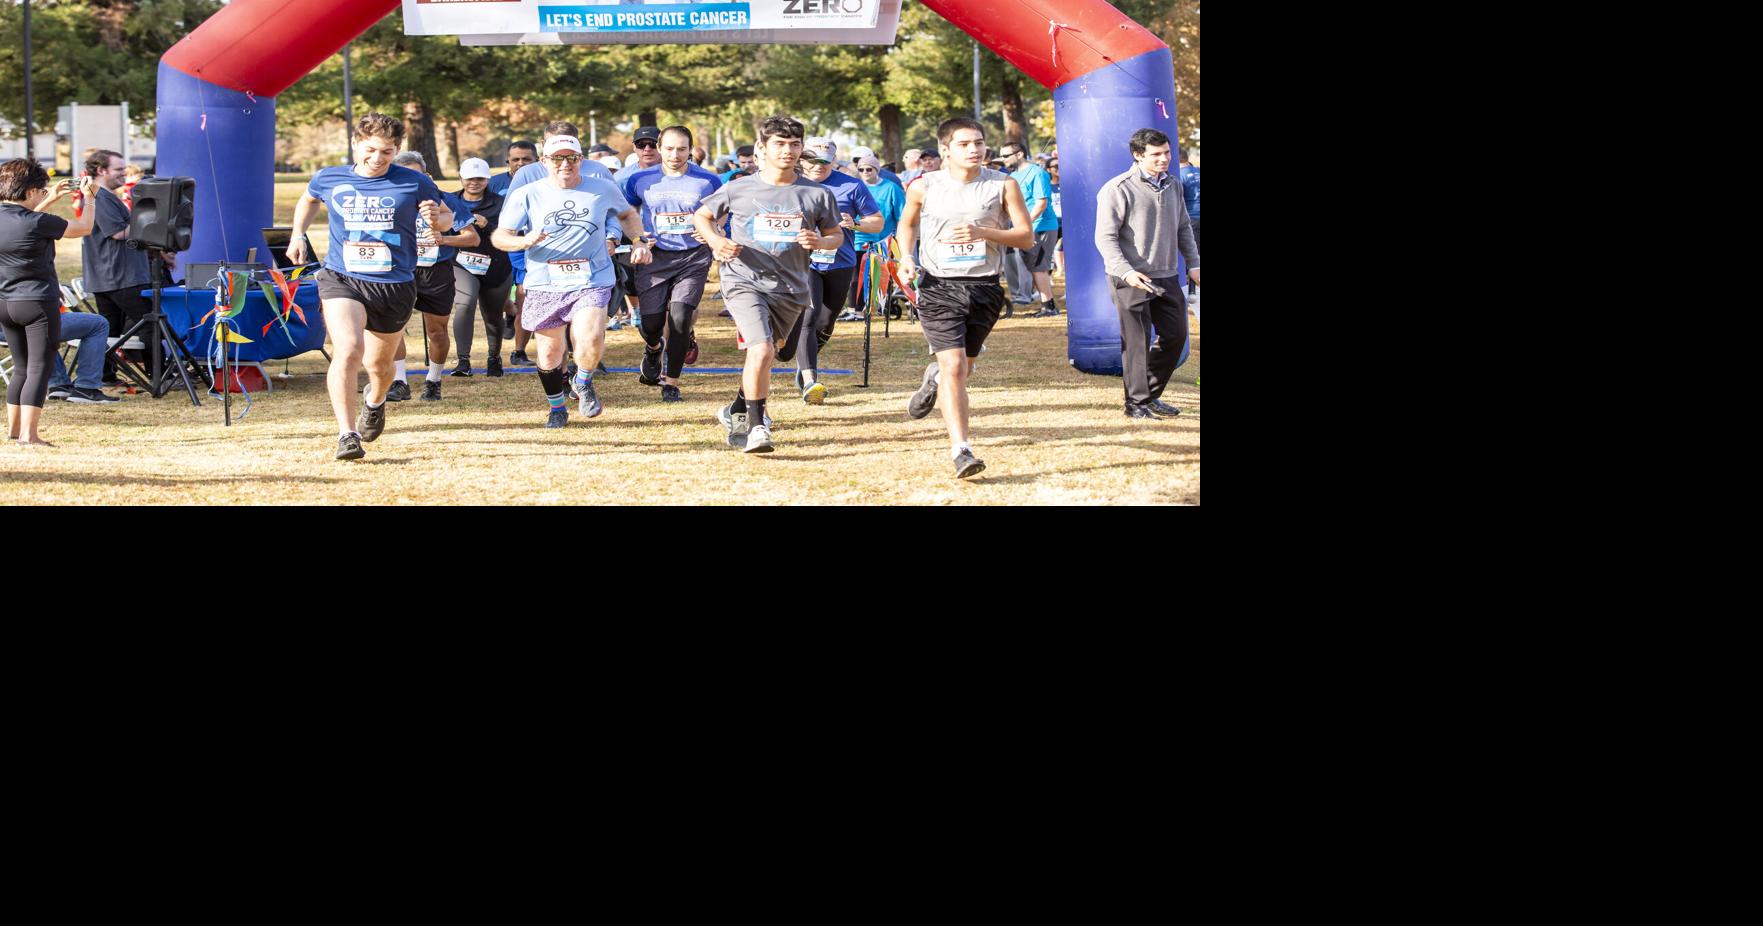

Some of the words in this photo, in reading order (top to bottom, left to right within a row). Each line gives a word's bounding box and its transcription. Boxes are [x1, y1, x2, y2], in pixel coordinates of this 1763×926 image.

[546, 13, 583, 27] LET'S
[586, 13, 613, 27] END
[617, 12, 686, 26] PROSTATE
[690, 11, 747, 25] CANCER
[342, 195, 396, 208] ZERO
[666, 215, 685, 223] 115
[766, 219, 791, 228] 120
[359, 247, 375, 256] 83
[950, 244, 974, 253] 119
[465, 255, 483, 263] 114
[559, 263, 580, 272] 103
